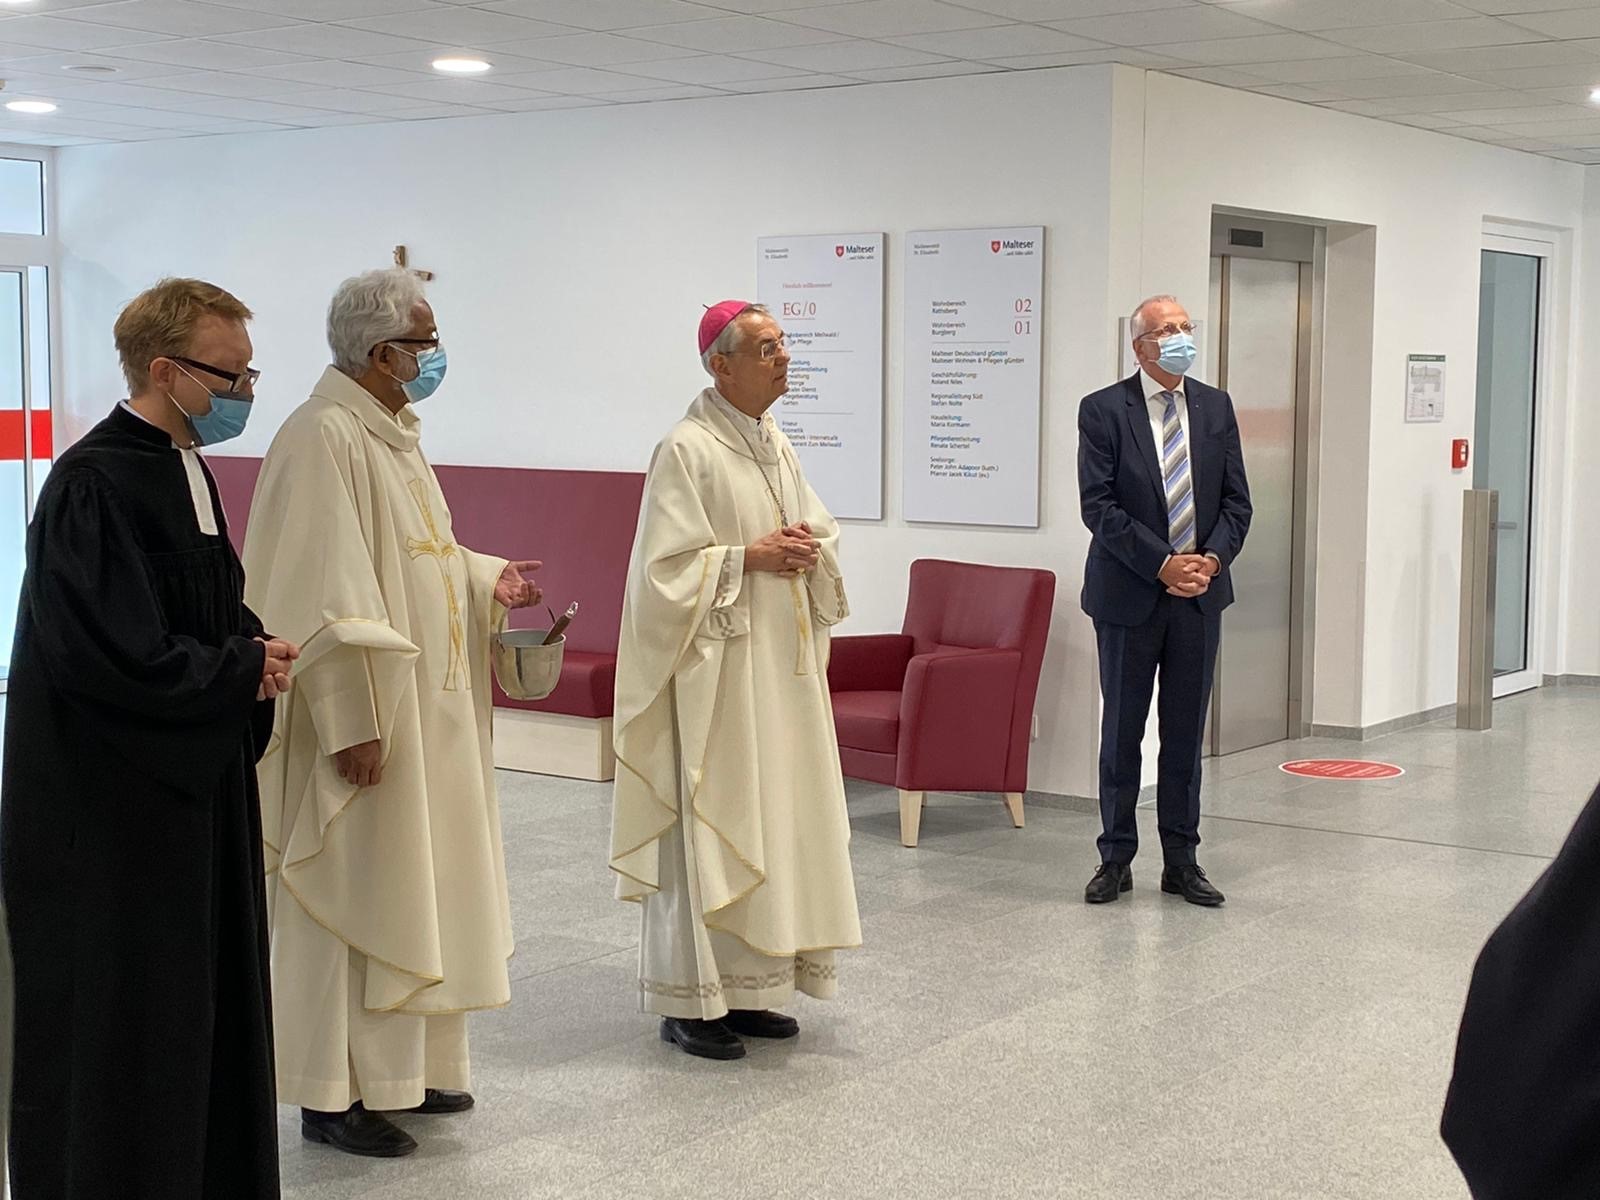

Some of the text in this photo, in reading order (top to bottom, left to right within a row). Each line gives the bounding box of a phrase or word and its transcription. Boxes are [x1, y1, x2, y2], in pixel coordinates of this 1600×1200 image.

[846, 245, 874, 253] Malteser
[1002, 240, 1034, 249] Malteser
[1015, 299, 1032, 313] 02
[1014, 321, 1031, 334] 01
